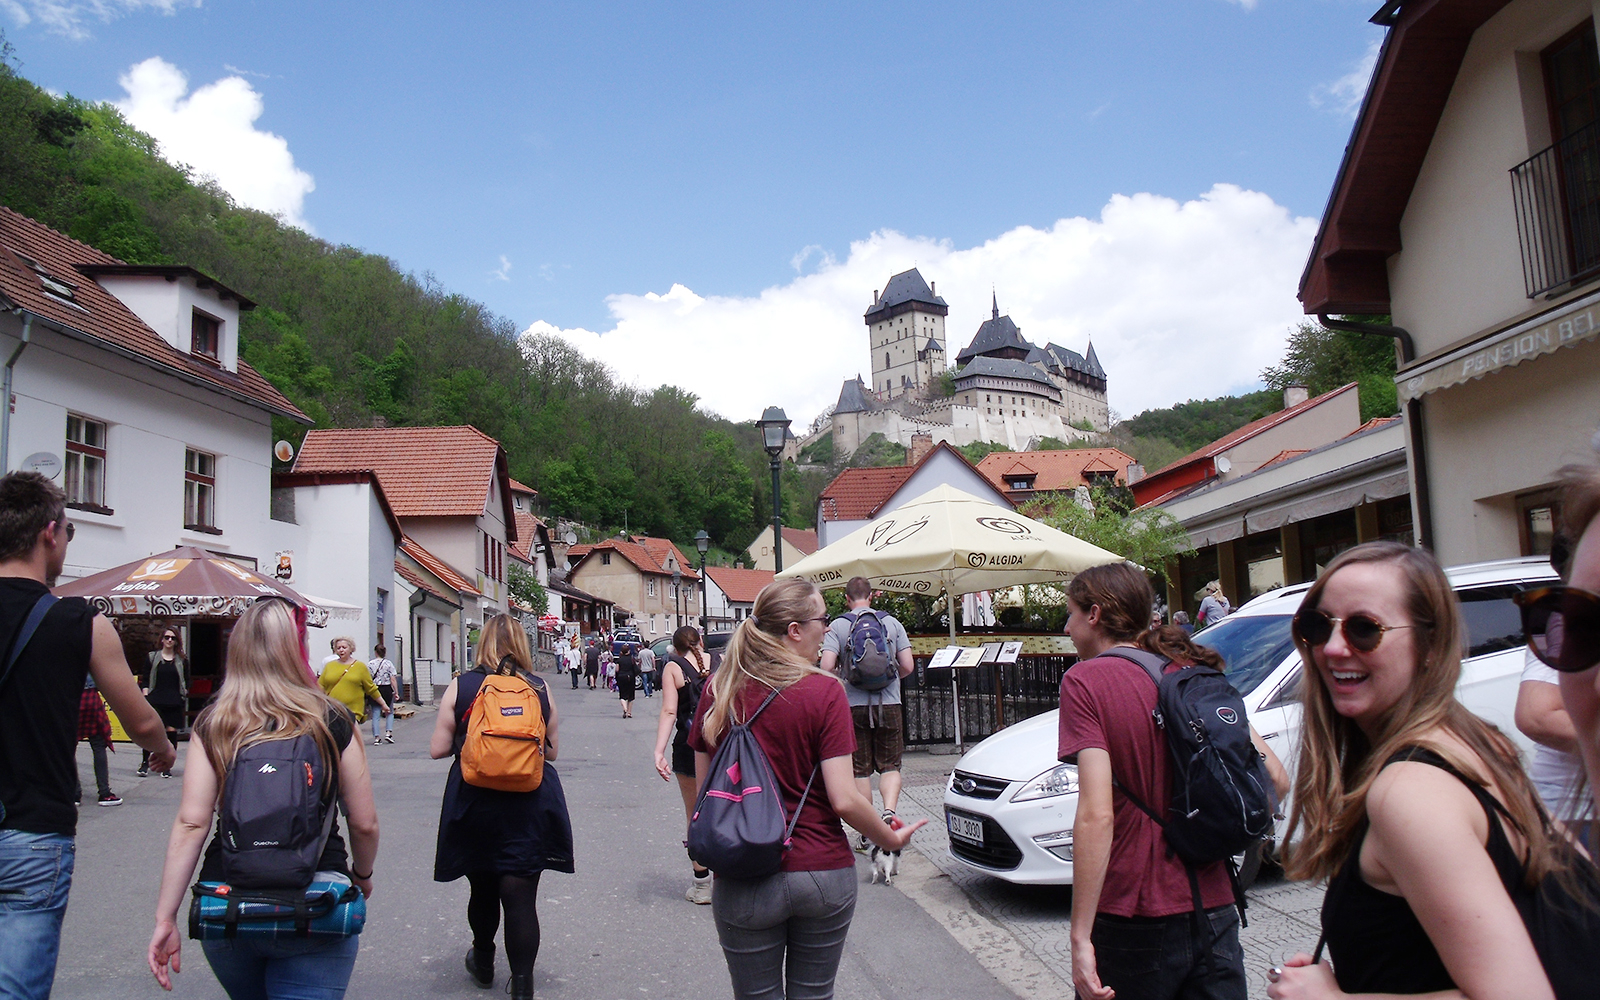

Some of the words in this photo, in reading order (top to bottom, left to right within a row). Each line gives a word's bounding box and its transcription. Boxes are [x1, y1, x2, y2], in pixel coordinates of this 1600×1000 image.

[1462, 328, 1550, 376] PENSION
[989, 555, 1023, 566] ALGIDA
[111, 582, 161, 593] kofola
